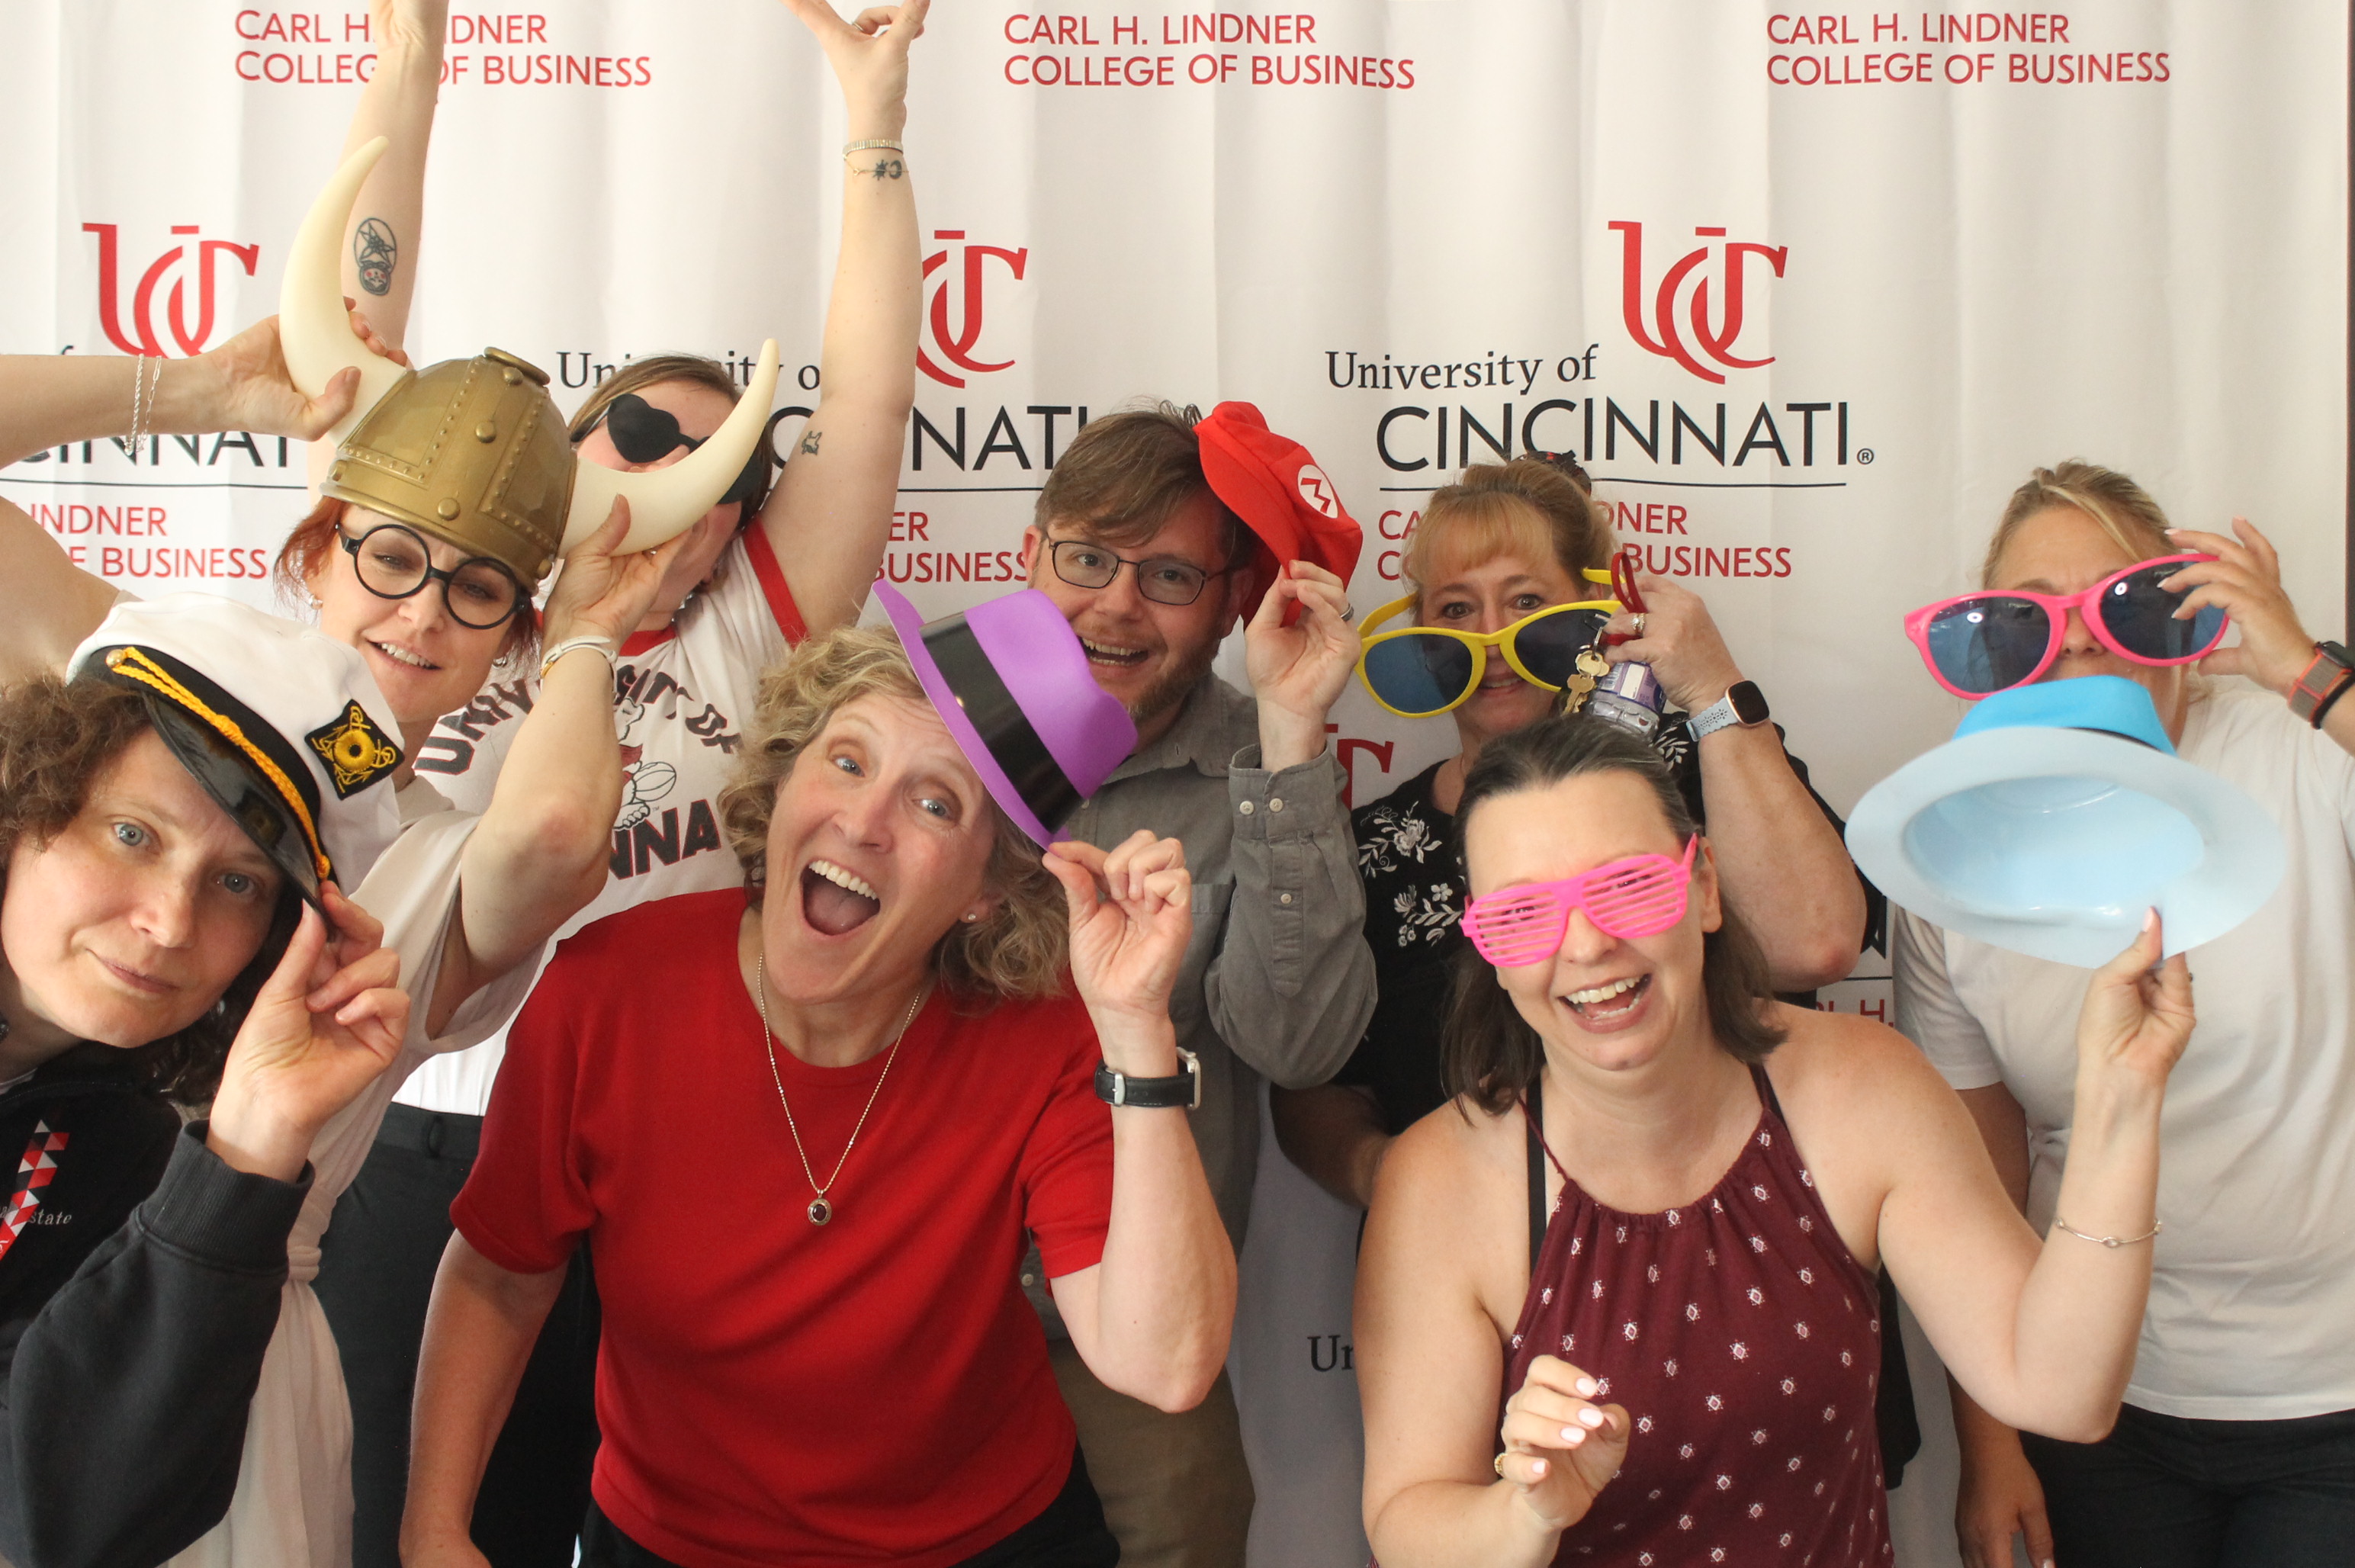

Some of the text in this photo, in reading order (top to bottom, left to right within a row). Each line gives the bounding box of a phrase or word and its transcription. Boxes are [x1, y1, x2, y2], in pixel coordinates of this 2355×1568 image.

[235, 10, 548, 43] CARL H DNER
[1004, 13, 1316, 45] CARL H. LINDNER
[1767, 13, 2070, 44] CARL H. LINDNER
[235, 50, 378, 83] COLLEG
[484, 54, 651, 87] BUSINESS
[1004, 53, 1415, 89] COLLEGE OF BUSINESS
[1766, 52, 2170, 85] COLLEGE OF BUSINESS
[1325, 343, 1599, 395] University of
[31, 503, 167, 536] INDNER
[101, 547, 268, 580] BUSINESS
[1621, 543, 1792, 578] BUSINESS
